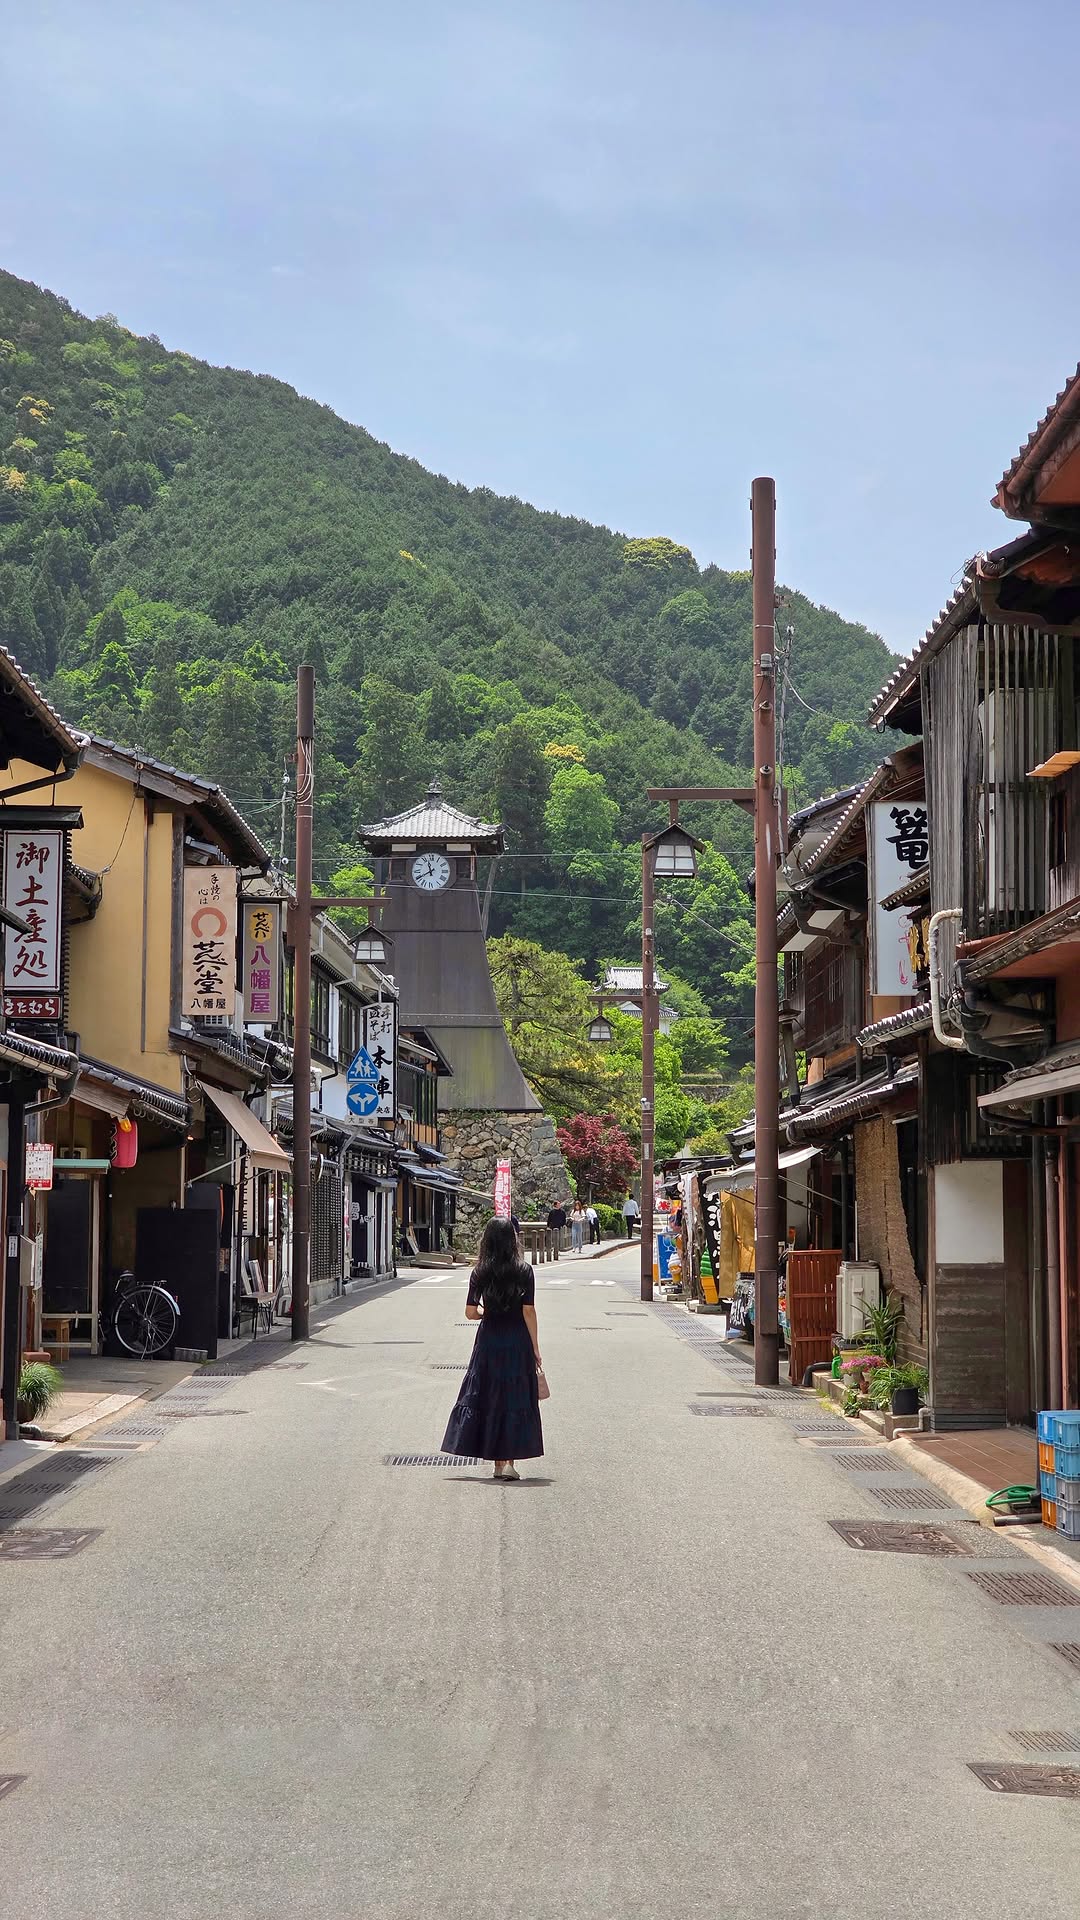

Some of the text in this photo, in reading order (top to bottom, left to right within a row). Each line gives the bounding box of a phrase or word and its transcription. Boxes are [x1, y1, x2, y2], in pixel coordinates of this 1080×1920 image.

[198, 887, 209, 905] 心は
[210, 873, 221, 901] 手焼の
[13, 841, 50, 978] 御土産処
[252, 911, 270, 938] せんべい
[250, 945, 271, 1013] 八幡屋
[3, 998, 57, 1016] きたむら
[190, 998, 227, 1010] 八幡屋
